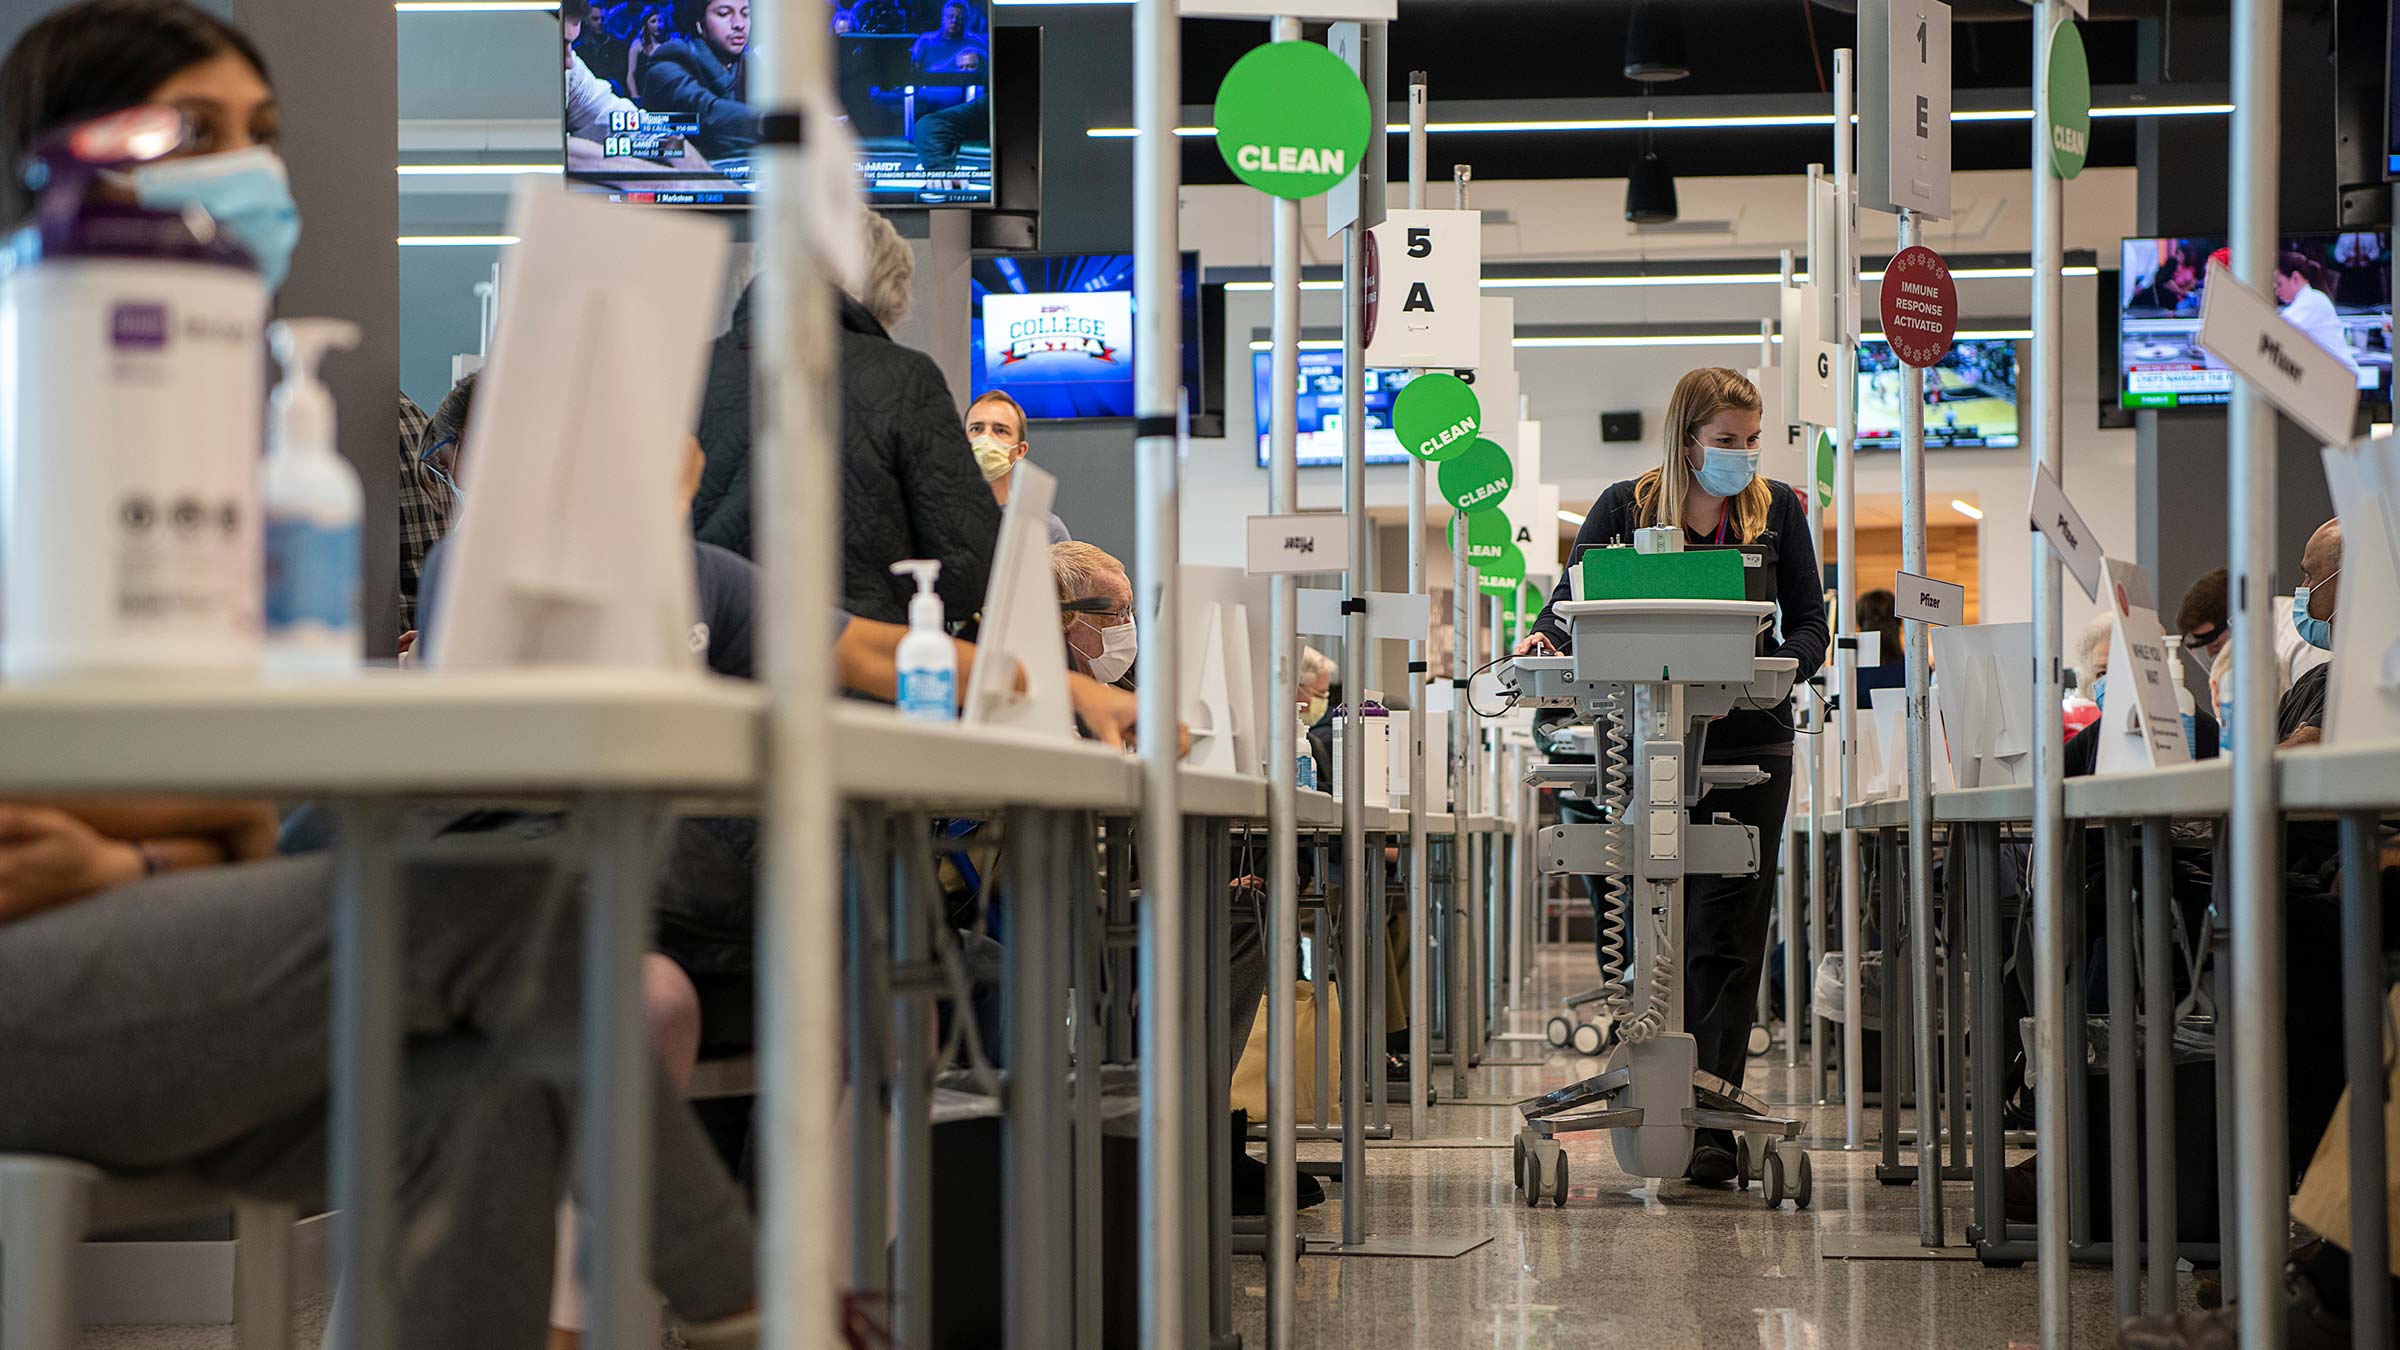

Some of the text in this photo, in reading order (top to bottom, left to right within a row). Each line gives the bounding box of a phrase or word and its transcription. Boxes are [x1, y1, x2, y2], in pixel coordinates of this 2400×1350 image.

[1916, 21, 1927, 64] 1
[1916, 95, 1928, 139] E
[2053, 125, 2086, 156] CLEAN
[1237, 145, 1345, 175] CLEAN
[1407, 228, 1432, 258] 5
[1403, 282, 1435, 312] A
[1901, 281, 1939, 298] IMMUNE
[1896, 298, 1943, 316] RESPONSE
[1009, 316, 1105, 339] COLLEGE
[1894, 315, 1943, 333] ACTIVATED
[1818, 352, 1829, 379] G
[1420, 416, 1477, 456] CLEAN
[1788, 425, 1801, 445] F
[1458, 477, 1508, 508] CLEAN
[1517, 526, 1531, 542] A
[2057, 512, 2078, 550] Pfizer
[1468, 545, 1502, 557] LEAN
[1920, 592, 1940, 608] Pfizer
